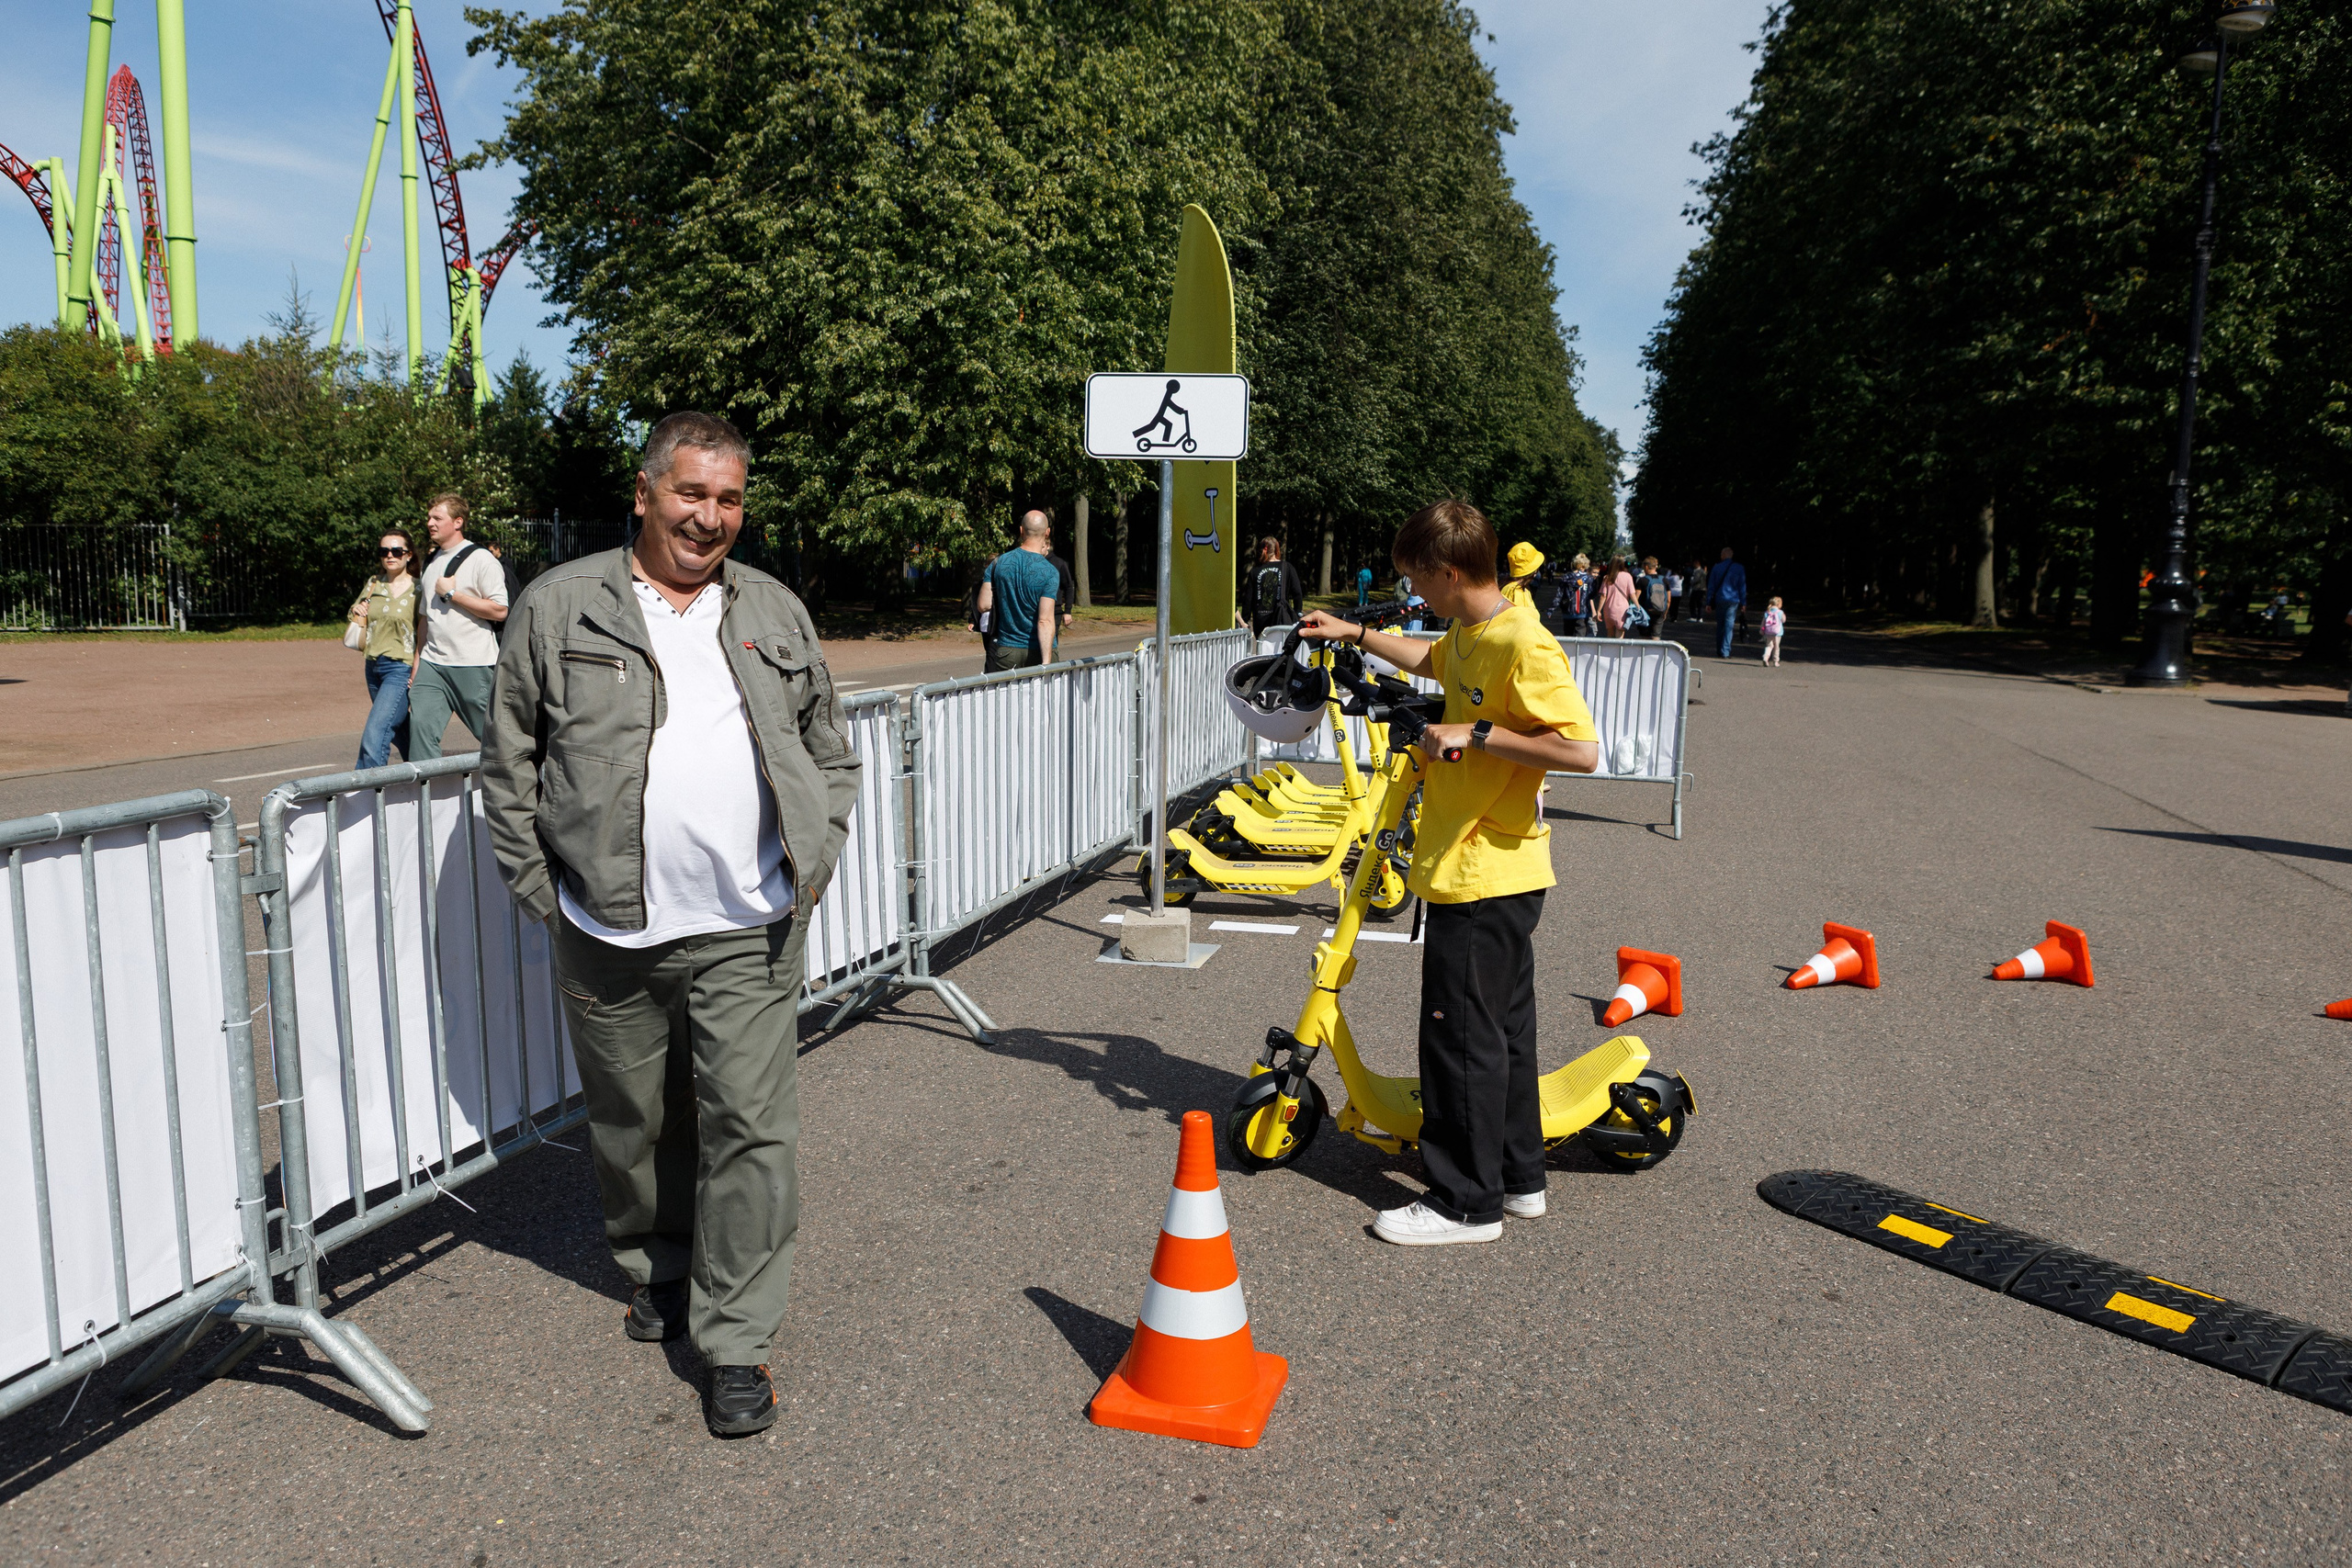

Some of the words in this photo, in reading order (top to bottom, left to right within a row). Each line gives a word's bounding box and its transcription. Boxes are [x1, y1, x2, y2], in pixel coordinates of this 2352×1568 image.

[1472, 690, 1482, 704] Go
[1335, 730, 1343, 742] Go
[1360, 853, 1385, 898] Яндекс
[1378, 831, 1395, 850] Go
